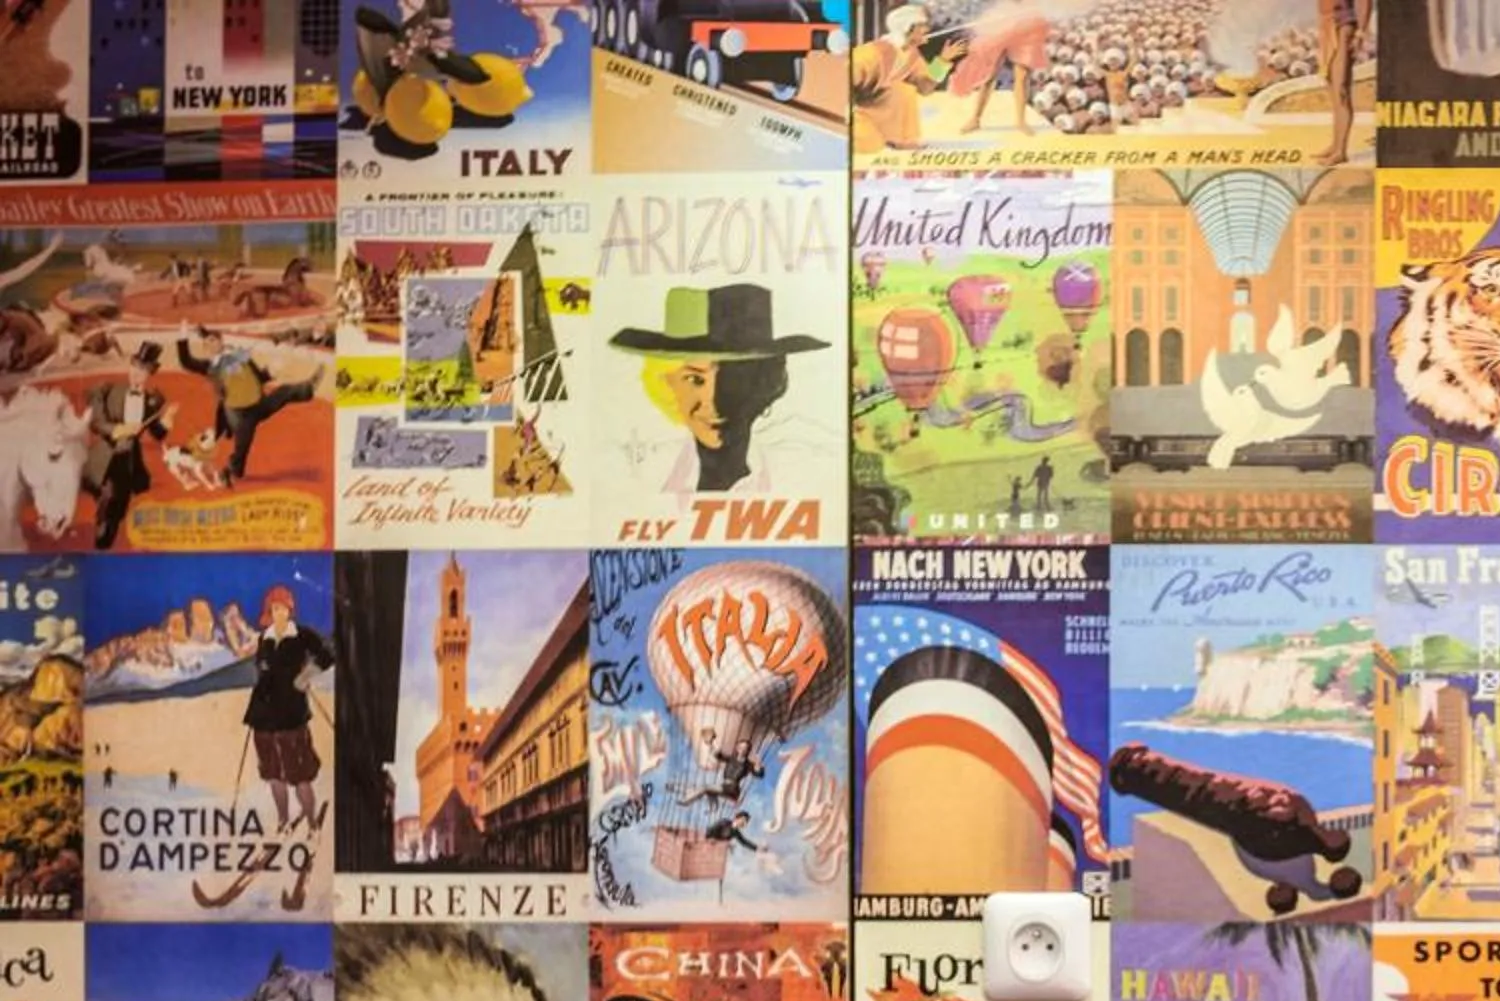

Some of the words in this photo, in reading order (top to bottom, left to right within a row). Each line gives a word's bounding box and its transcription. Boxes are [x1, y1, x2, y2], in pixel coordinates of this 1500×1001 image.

[185, 65, 204, 80] to
[173, 87, 222, 108] NEW
[229, 85, 287, 107] YORK
[1377, 101, 1484, 128] NIAGARA
[460, 149, 573, 177] ITALY
[909, 151, 980, 165] SHOOTS
[988, 151, 1002, 165] A
[1010, 150, 1097, 165] CRACKER
[1105, 150, 1157, 164] FROM
[1164, 150, 1178, 164] A
[1250, 150, 1302, 164] HEAD
[340, 205, 448, 236] SOUTH
[456, 203, 590, 235] DAKOTA
[1381, 185, 1495, 241] RINGLING
[597, 196, 838, 276] ARIZONA
[853, 195, 976, 250] United
[977, 198, 1112, 269] Kingdom
[1407, 228, 1463, 259] BROS
[343, 475, 416, 499] Land
[445, 498, 534, 529] Variety
[617, 520, 676, 541] FLY
[690, 499, 820, 541] TWA
[929, 513, 1060, 529] UNITED
[872, 551, 944, 579] NACH
[953, 551, 1013, 579] NEW
[1015, 550, 1088, 579] YORK
[1385, 550, 1449, 585] San
[1151, 568, 1258, 613] Puerto
[1257, 551, 1333, 602] Rico
[656, 587, 829, 716] ITALIA
[100, 808, 264, 837] CORTINA
[359, 884, 568, 916] FIRENZE
[615, 944, 815, 980] CHINA
